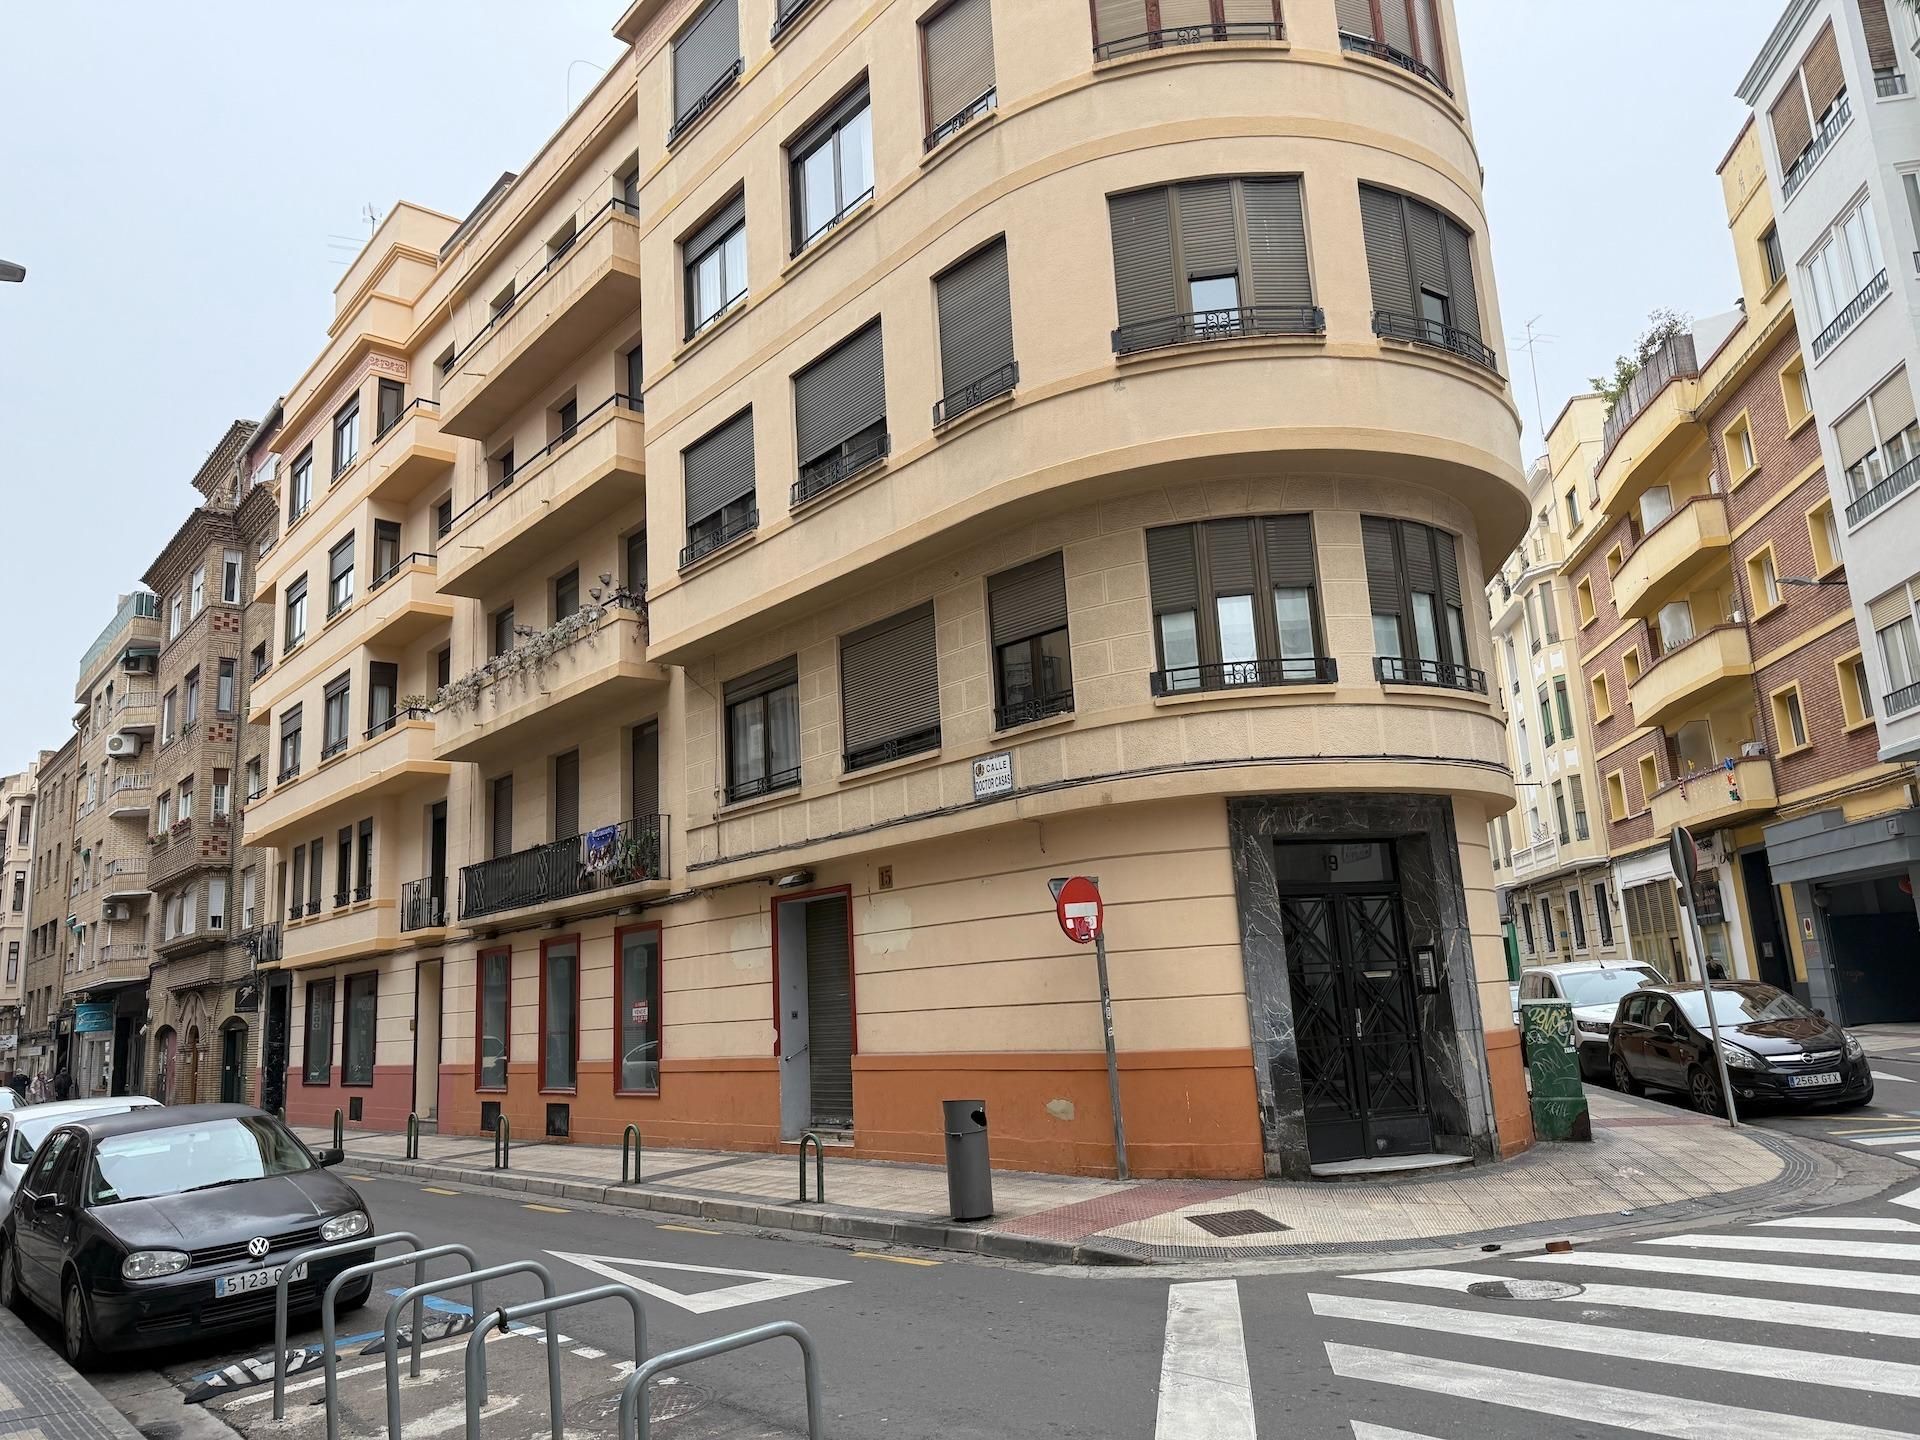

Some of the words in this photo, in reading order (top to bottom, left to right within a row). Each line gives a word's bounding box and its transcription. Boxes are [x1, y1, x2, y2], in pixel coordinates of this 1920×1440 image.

[986, 760, 1007, 773] CALLE
[975, 777, 995, 792] DOCTOR
[994, 773, 1011, 788] CASAS
[1796, 1075, 1819, 1086] 2563
[1821, 1073, 1839, 1084] GTX
[227, 1271, 268, 1292] 5123
